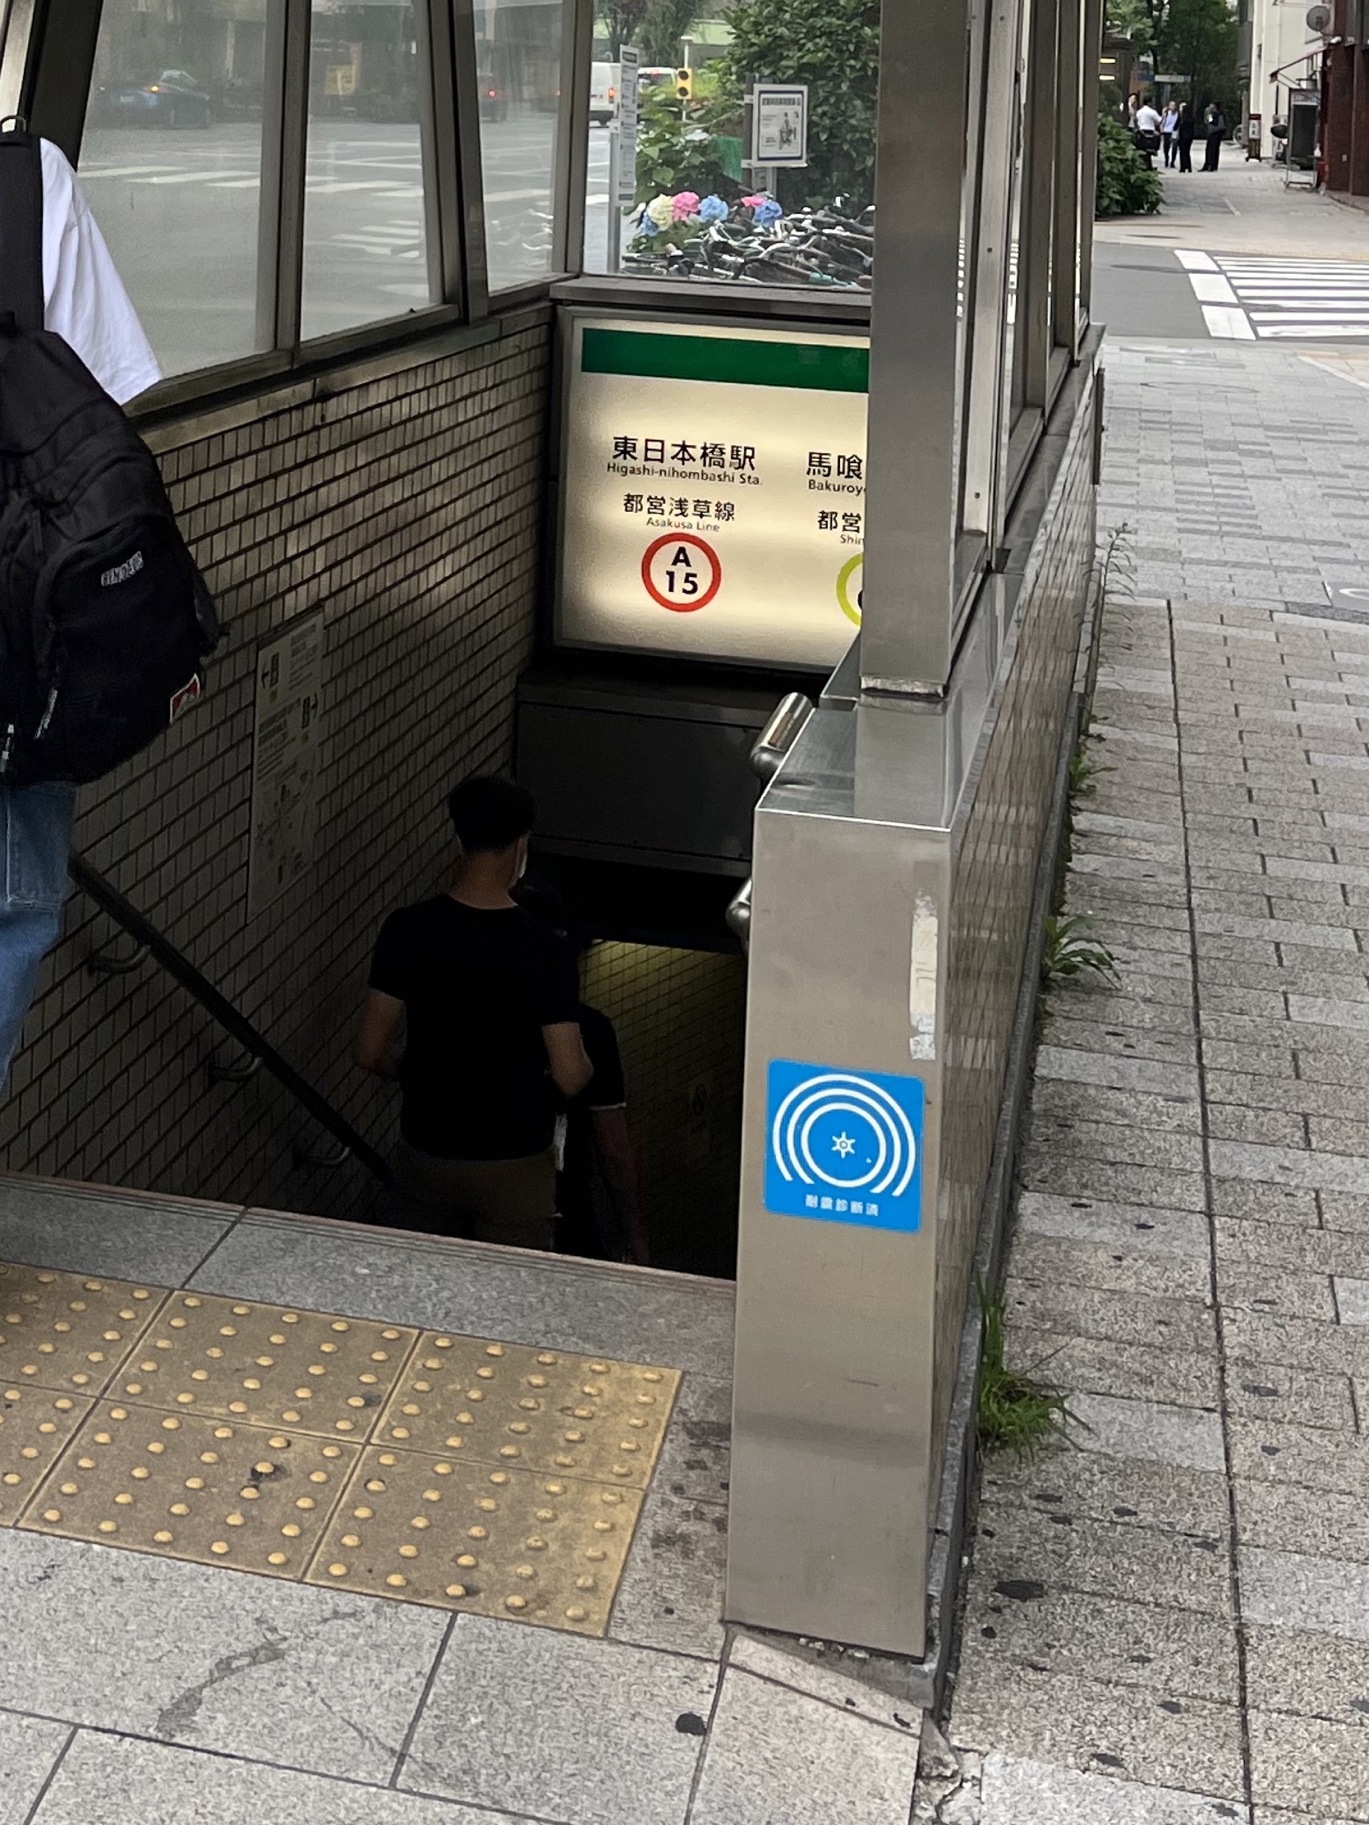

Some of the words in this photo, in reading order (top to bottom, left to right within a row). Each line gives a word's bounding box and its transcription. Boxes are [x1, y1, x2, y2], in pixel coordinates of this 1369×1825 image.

[612, 436, 756, 472] 東日本橋駅
[806, 451, 863, 480] 馬喰
[607, 463, 734, 483] Higashi-nihombashi
[808, 478, 866, 497] Bakuroy
[624, 493, 735, 521] 都営浅草線
[817, 510, 862, 534] 都営
[646, 516, 693, 530] Asakusa
[696, 521, 720, 533] Line
[671, 547, 692, 568] A
[665, 570, 699, 595] 15
